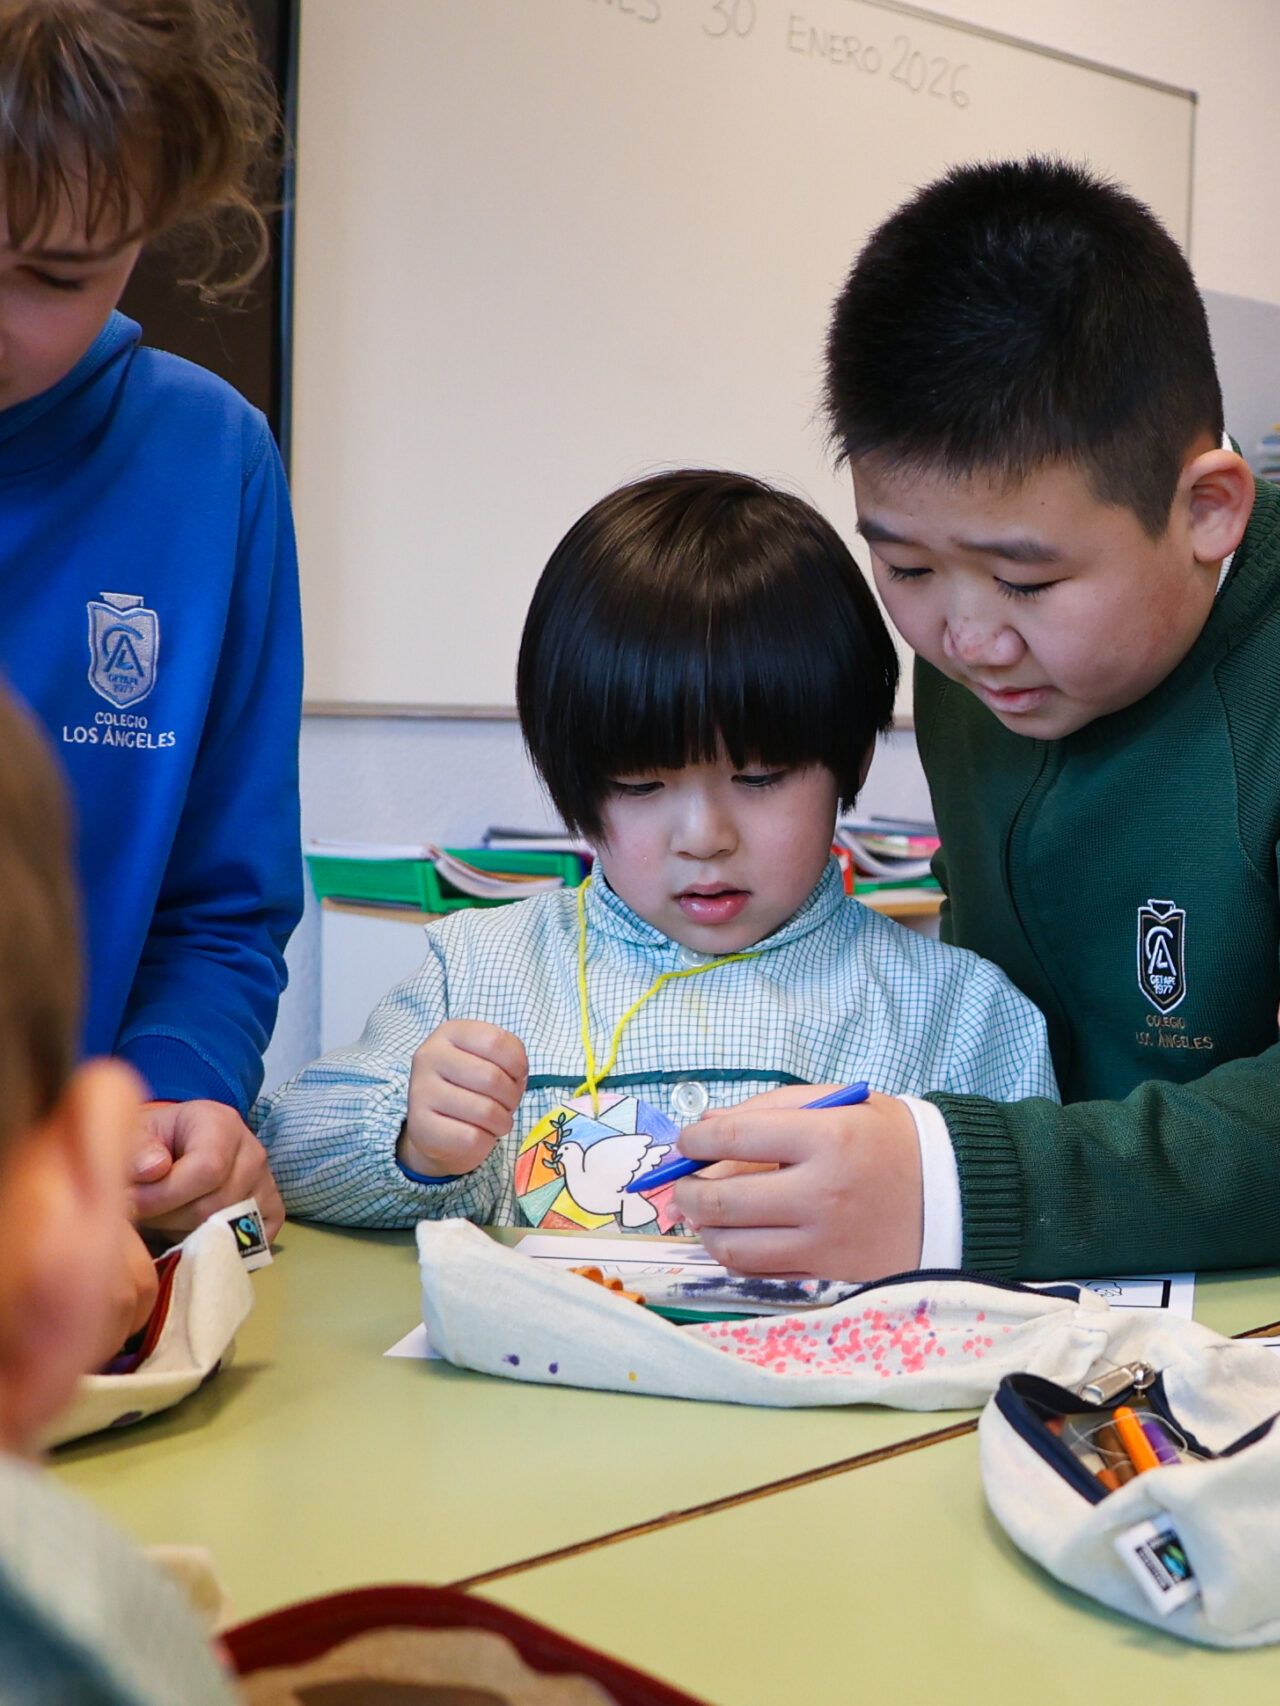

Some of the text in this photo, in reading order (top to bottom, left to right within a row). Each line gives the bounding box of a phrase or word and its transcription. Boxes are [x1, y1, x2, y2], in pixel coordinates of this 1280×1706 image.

[702, 0, 970, 109] 30 ENERO 2026
[94, 711, 148, 730] COLEGIO
[63, 725, 176, 749] LOS ÁNGELES
[1153, 984, 1174, 995] 1977
[1145, 1014, 1185, 1029] COLEGIO
